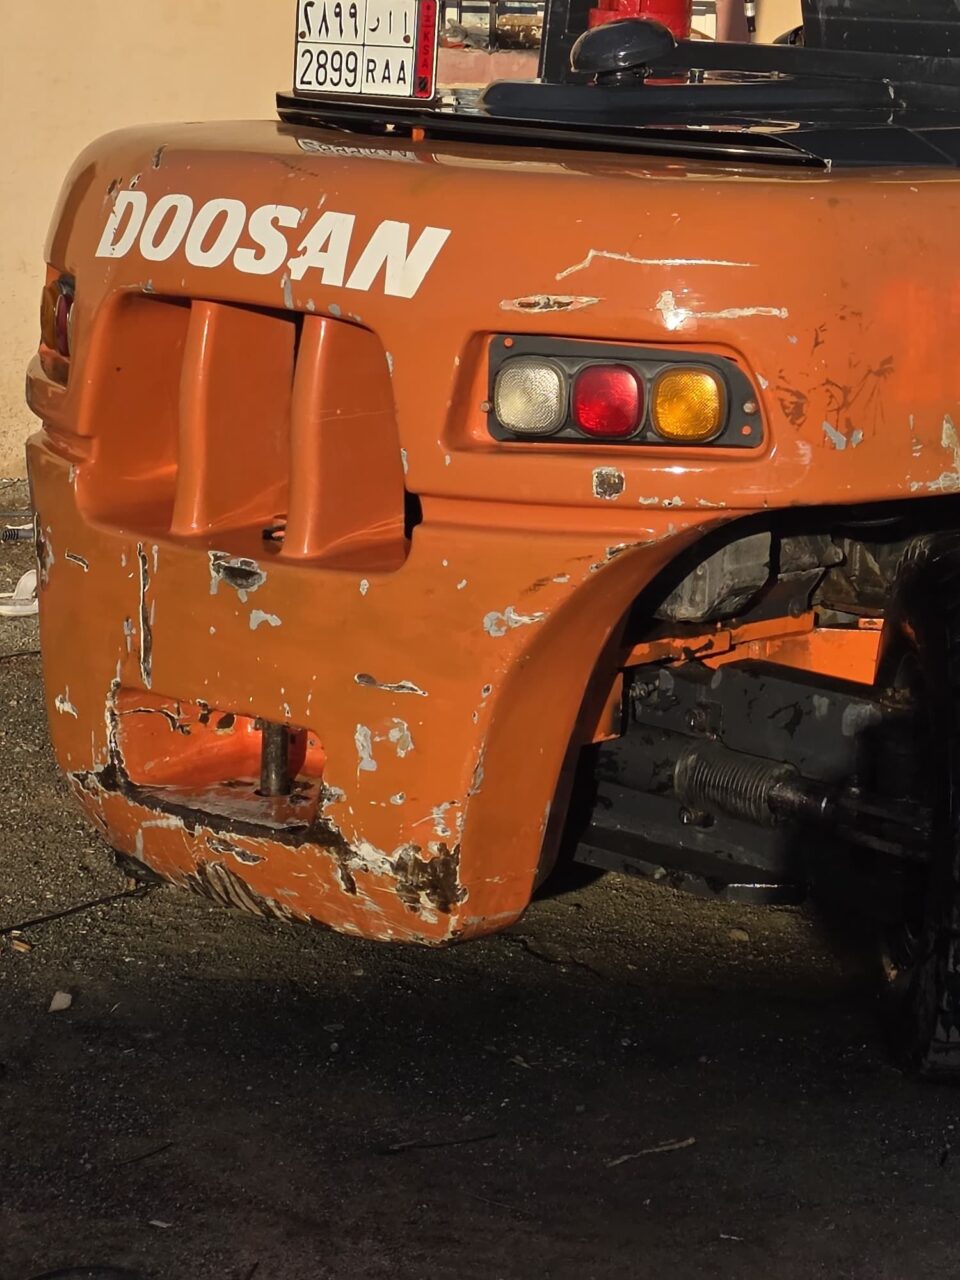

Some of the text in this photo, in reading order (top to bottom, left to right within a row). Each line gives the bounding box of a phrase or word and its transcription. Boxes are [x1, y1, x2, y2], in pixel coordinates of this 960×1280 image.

[303, 0, 359, 39] ٢٨٩٩
[299, 48, 406, 88] 2899 RAA
[95, 190, 452, 299] DOOSAN
